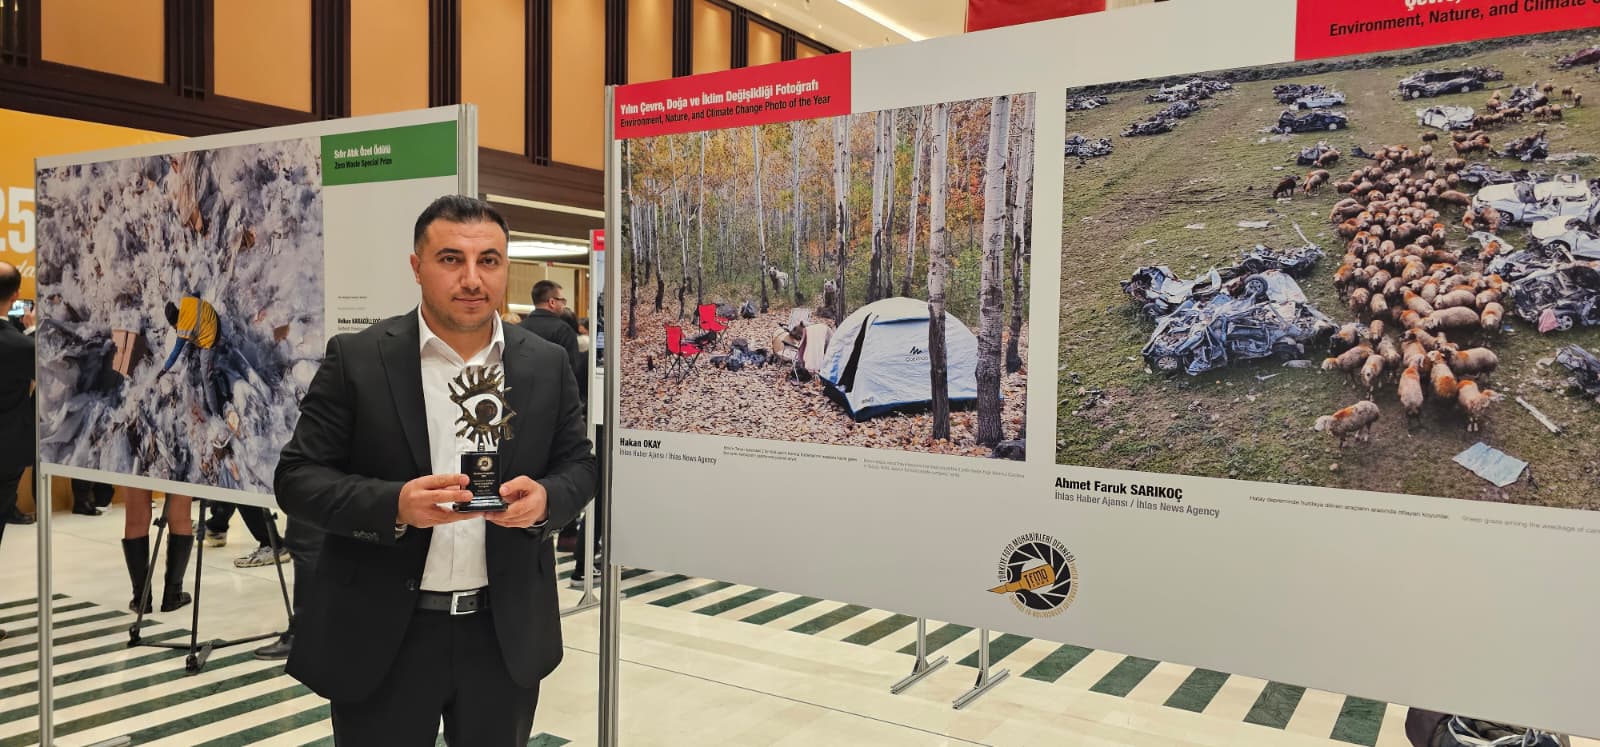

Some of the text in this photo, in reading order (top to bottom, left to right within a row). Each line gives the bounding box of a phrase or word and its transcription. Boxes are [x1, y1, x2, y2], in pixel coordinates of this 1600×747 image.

[1329, 13, 1424, 36] Environment,
[1429, 8, 1484, 23] Nature,
[1489, 2, 1518, 16] and
[620, 79, 819, 116] Yılın Çevre, Doğa ve İklim Değişikliği Fotoğrafı
[620, 95, 831, 128] Environment, Nature, and Climate Change Photo of the Year
[361, 158, 378, 168] Special
[619, 437, 661, 449] Hakan OKAY
[683, 454, 697, 463] News
[698, 455, 717, 465] Agency
[1054, 477, 1184, 503] Ahmet Faruk SARIKOÇ
[1076, 492, 1101, 505] Haber
[1101, 496, 1128, 508] Ajansı
[1130, 499, 1135, 508] /
[1160, 502, 1185, 514] News
[1186, 505, 1220, 518] Agency
